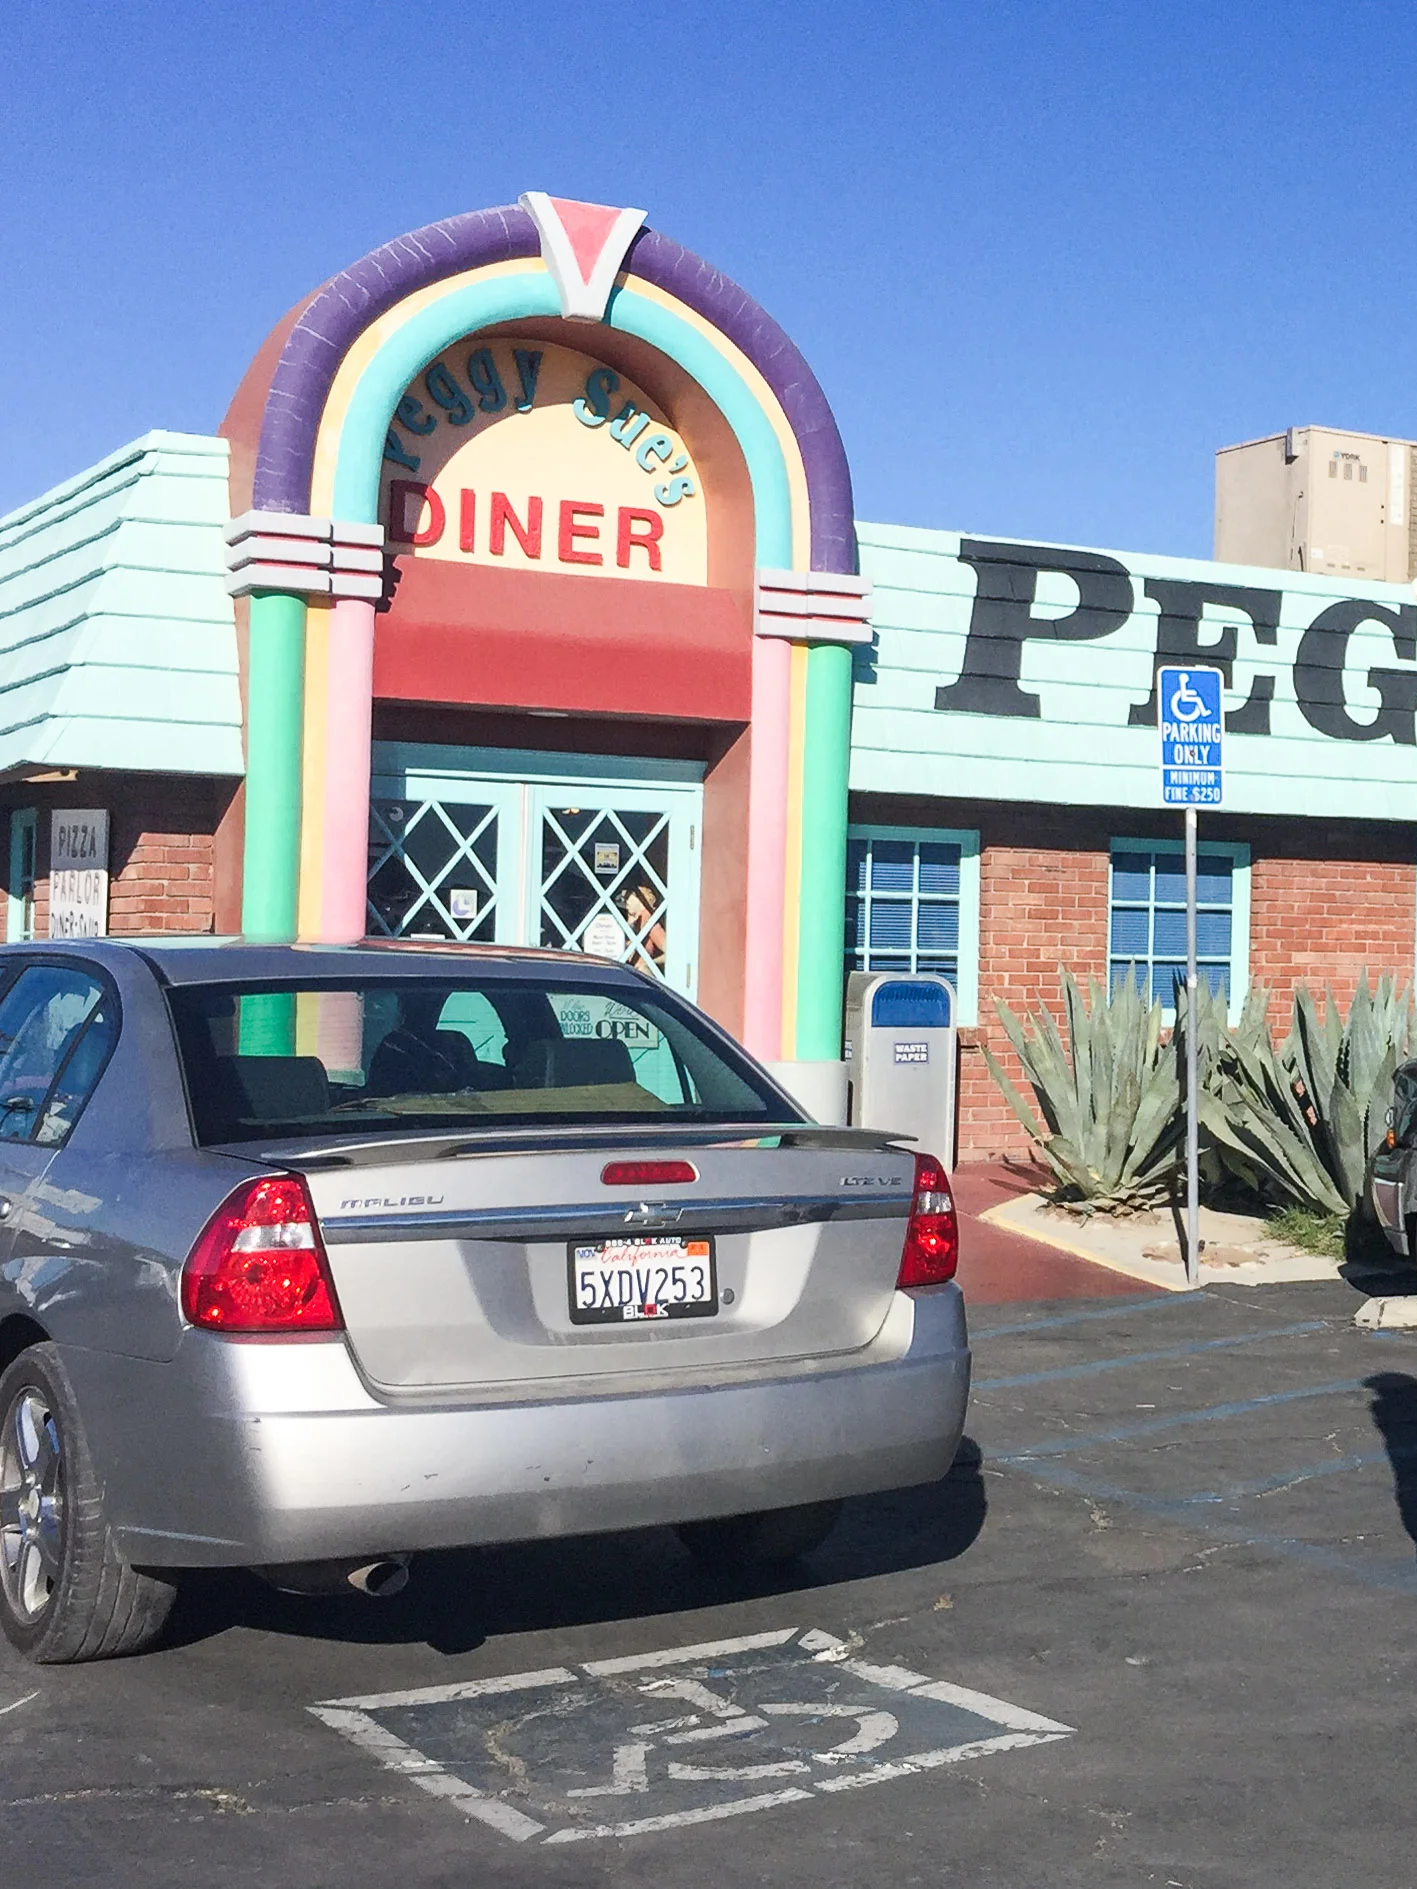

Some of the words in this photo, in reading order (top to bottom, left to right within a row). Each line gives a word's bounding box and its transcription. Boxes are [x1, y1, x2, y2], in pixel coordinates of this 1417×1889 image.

[573, 368, 696, 507] Sue's
[1341, 452, 1360, 460] YORK
[389, 479, 664, 572] DINER
[1162, 722, 1221, 744] PARKING
[1173, 744, 1210, 765] ONLY
[1170, 771, 1215, 785] MINIMUM
[1165, 786, 1188, 801] FINE
[1192, 787, 1221, 802] $250
[58, 825, 97, 858] PIZZA
[52, 871, 101, 905] PARLOR
[595, 1019, 650, 1039] OPEN
[895, 1044, 927, 1053] WASTE
[895, 1053, 927, 1062] PAPER
[340, 1196, 444, 1209] MALIBU
[660, 1236, 682, 1245] AUTO
[580, 1266, 704, 1309] 5XDV253
